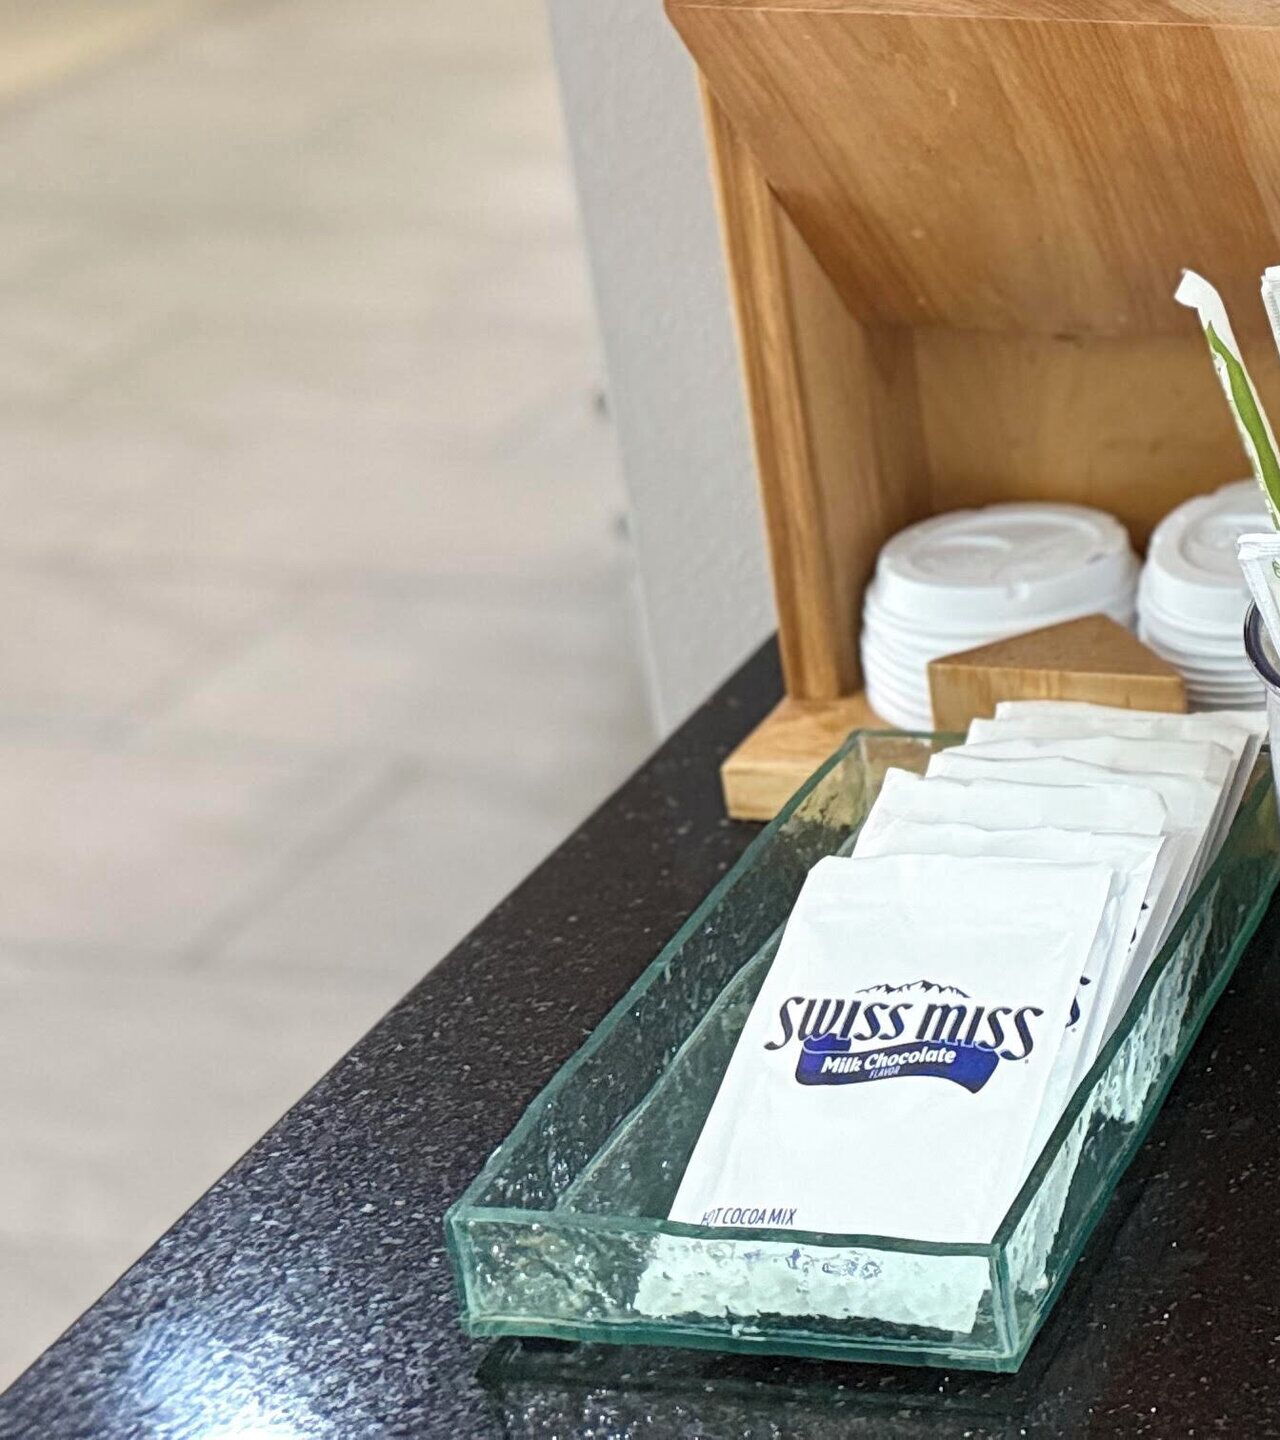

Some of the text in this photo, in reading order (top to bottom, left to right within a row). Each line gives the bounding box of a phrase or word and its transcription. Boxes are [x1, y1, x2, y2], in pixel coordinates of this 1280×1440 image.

[764, 996, 911, 1051] SWISS
[821, 1046, 957, 1074] Milk Chocolate
[869, 1066, 900, 1079] FLAVOR
[723, 1207, 766, 1225] COCOA
[767, 1208, 798, 1226] MIX
